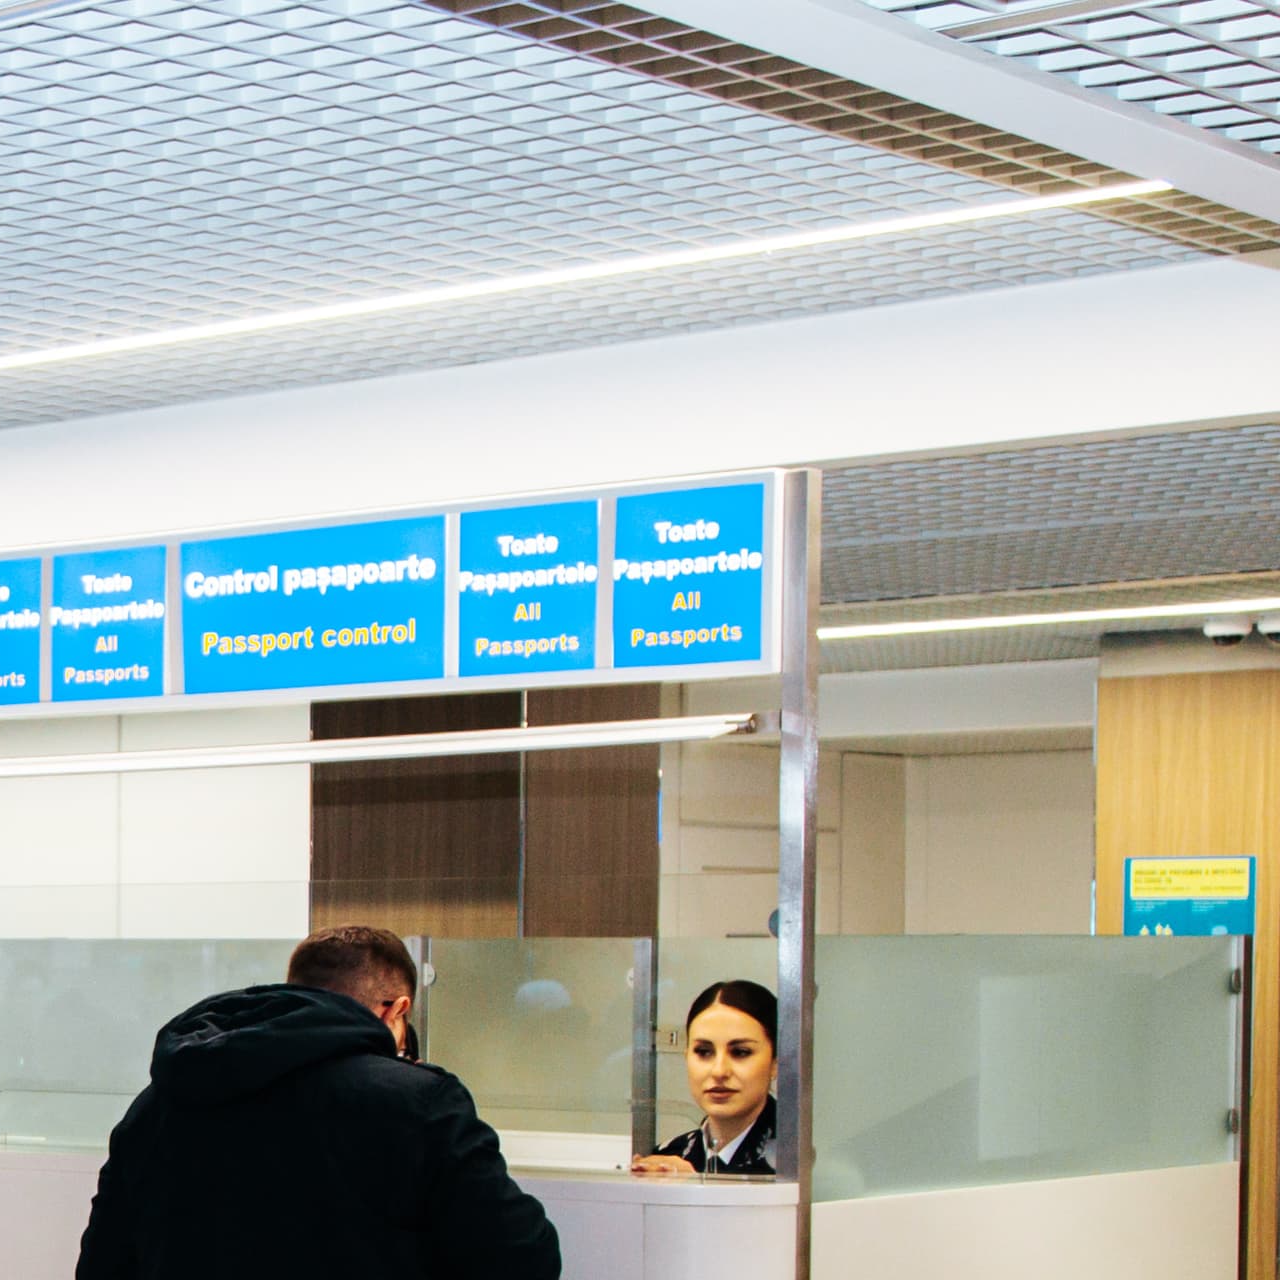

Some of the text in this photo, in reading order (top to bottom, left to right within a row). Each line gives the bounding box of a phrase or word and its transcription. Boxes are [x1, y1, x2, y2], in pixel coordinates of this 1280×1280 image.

[654, 519, 720, 544] Toate
[497, 533, 559, 557] Toate
[80, 573, 132, 595] Toate
[184, 565, 278, 599] Control
[514, 602, 541, 621] All
[672, 591, 700, 611] All
[95, 635, 118, 652] All
[202, 618, 416, 657] Passport control
[475, 634, 579, 658] Passports
[631, 624, 742, 648] Passports
[64, 664, 149, 685] Passports
